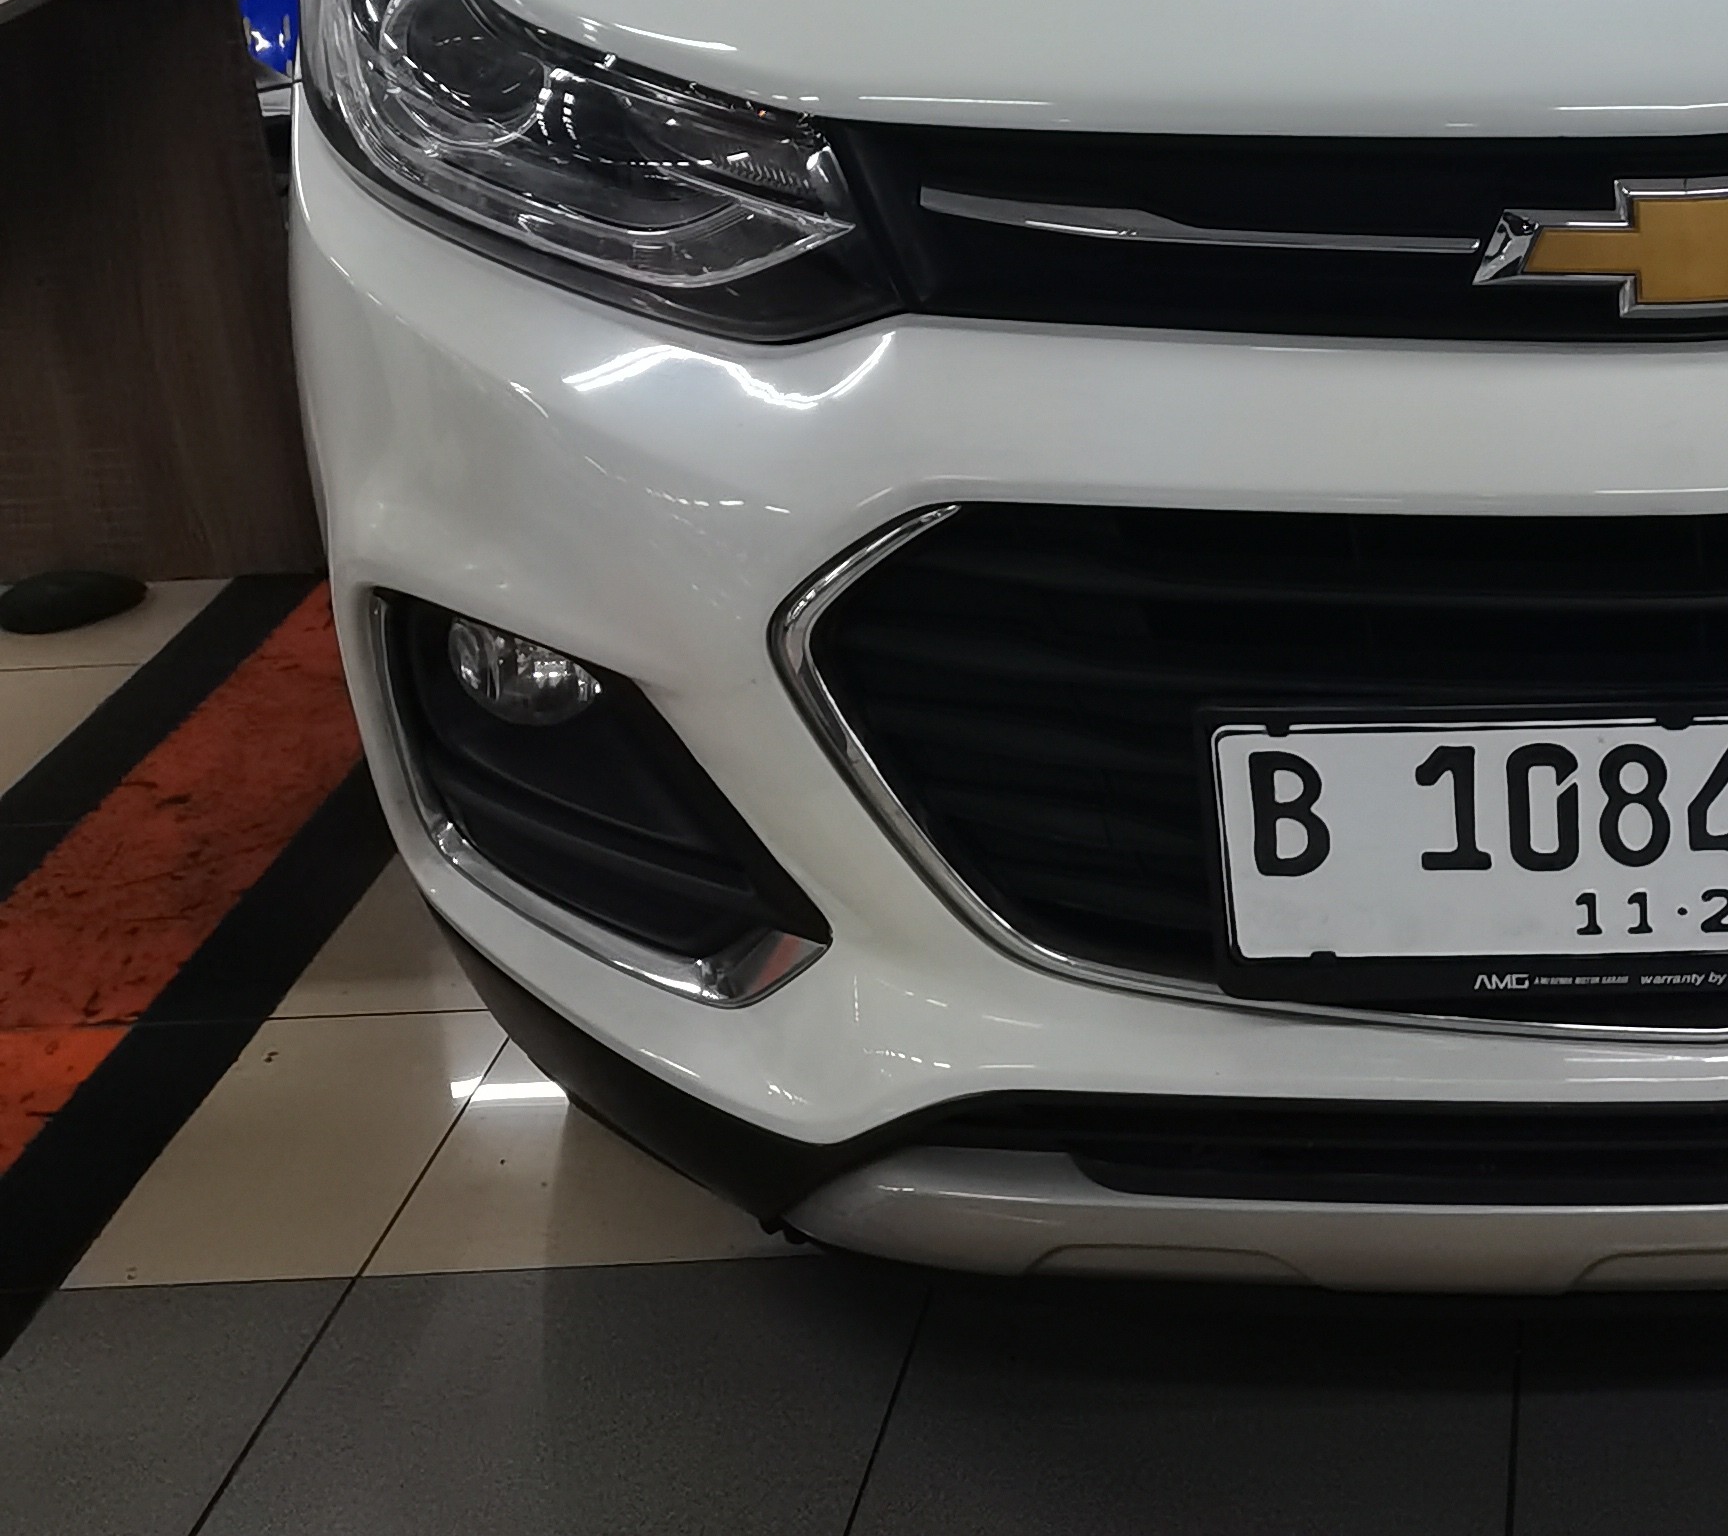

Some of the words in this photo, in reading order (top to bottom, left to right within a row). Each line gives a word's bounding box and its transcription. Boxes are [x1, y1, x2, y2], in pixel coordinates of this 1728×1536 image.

[1248, 749, 1331, 878] B
[1474, 973, 1530, 990] AMG
[1640, 972, 1706, 986] warranty
[1708, 971, 1727, 985] by
